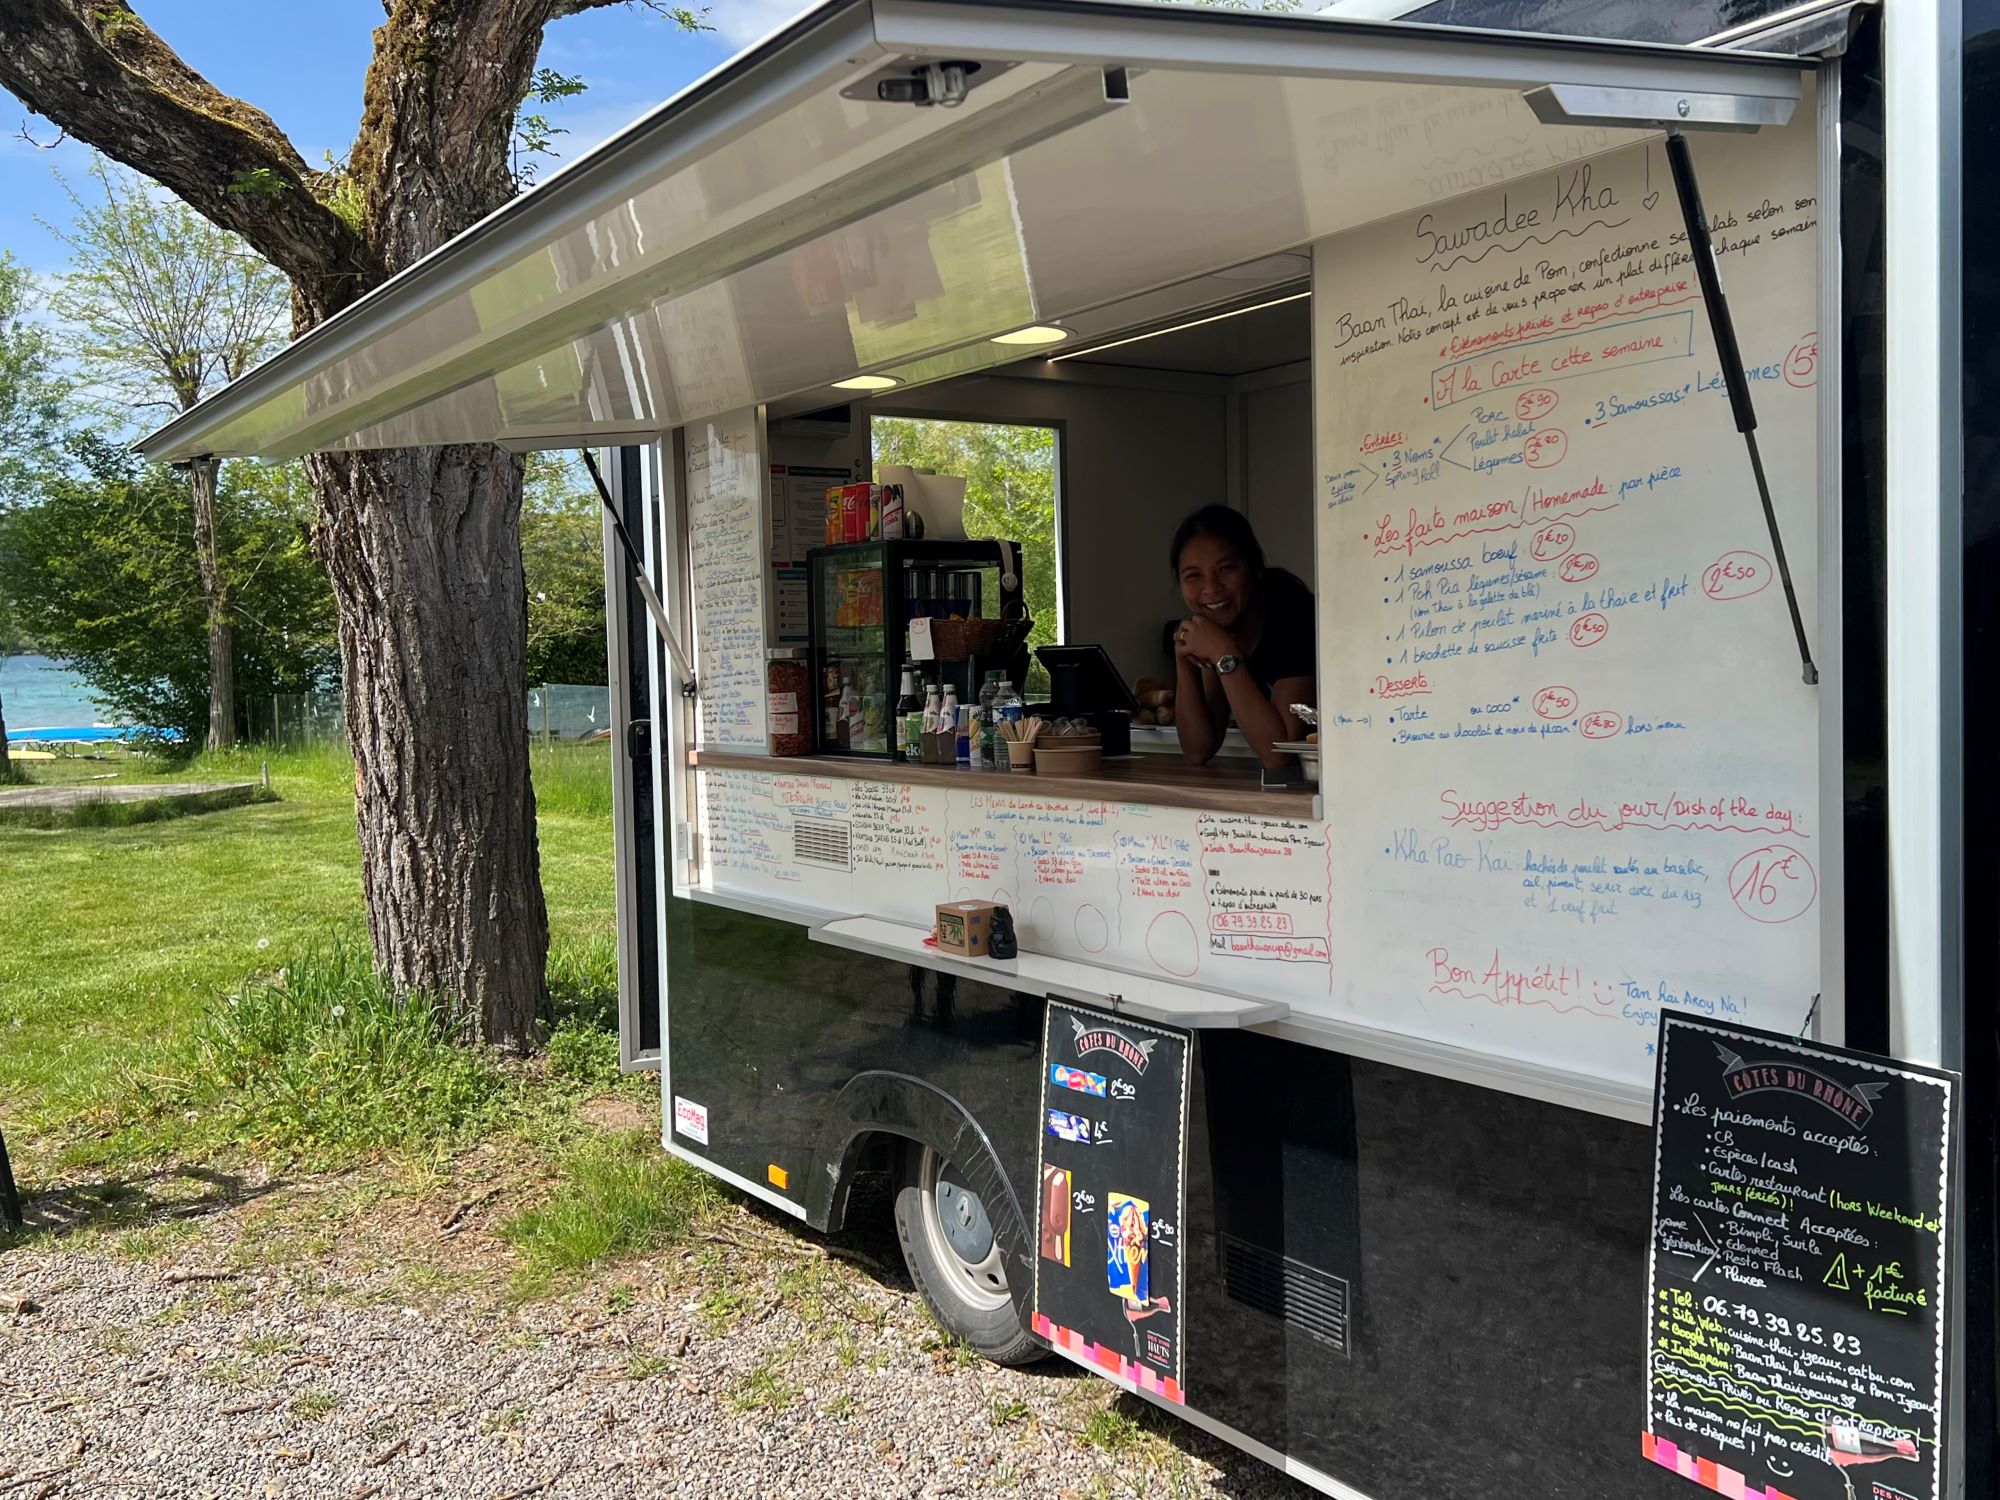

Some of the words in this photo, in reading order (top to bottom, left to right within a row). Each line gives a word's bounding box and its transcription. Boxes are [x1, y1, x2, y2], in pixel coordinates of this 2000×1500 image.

[1552, 164, 1620, 221] Kha
[1334, 312, 1386, 348] Baan
[1437, 284, 1458, 311] la
[1463, 281, 1510, 304] cuisine
[1513, 266, 1532, 289] de
[1579, 239, 1660, 274] confectionne
[1746, 200, 1784, 220] selon
[1794, 198, 1817, 211] son
[1398, 327, 1421, 344] Notre
[1425, 313, 1462, 335] concept
[1466, 308, 1480, 322] est
[1486, 303, 1499, 317] de
[1502, 298, 1527, 312] vous
[1532, 281, 1587, 310] proposer
[1593, 276, 1613, 290] un
[1616, 266, 1645, 289] plat
[1714, 235, 1761, 256] chaque
[1561, 309, 1573, 323] et
[1577, 301, 1609, 318] repas
[1462, 366, 1482, 392] la
[1491, 355, 1543, 388] Carte
[1551, 345, 1592, 370] cette
[1602, 336, 1664, 359] semaine
[1595, 401, 1606, 421] 3
[1467, 432, 1499, 451] Poulet
[1501, 422, 1536, 442] halal
[1392, 451, 1401, 466] 3
[1473, 453, 1525, 475] Légumes
[1384, 469, 1420, 491] Spring
[1374, 512, 1400, 546] Les
[1402, 504, 1445, 556] faits
[1453, 501, 1518, 526] maison
[1618, 478, 1644, 500] par
[1648, 466, 1682, 492] pièce
[1394, 570, 1404, 583] 1
[1409, 557, 1473, 579] samoussa
[1395, 591, 1404, 602] 1
[1396, 628, 1404, 641] 1
[1411, 621, 1446, 638] Pilon
[1452, 619, 1466, 633] de
[1470, 610, 1514, 640] poulet
[1521, 605, 1561, 623] mariné
[1568, 602, 1577, 615] à
[1581, 592, 1596, 611] la
[1644, 583, 1656, 601] et
[1661, 575, 1688, 610] frit
[1708, 562, 1756, 593] 2€50
[1468, 593, 1478, 606] la
[1508, 591, 1519, 599] de
[1400, 650, 1408, 663] 1
[1413, 645, 1462, 663] brochette
[1468, 644, 1478, 654] de
[1395, 705, 1429, 721] Tarte
[1470, 707, 1483, 715] ou
[1439, 731, 1450, 739] au
[1454, 723, 1492, 738] chocolat
[1494, 727, 1504, 736] et
[1529, 722, 1538, 733] de
[1440, 789, 1558, 832] Suggestion
[1568, 797, 1607, 821] du
[1710, 798, 1725, 822] of
[1730, 797, 1758, 817] the
[1394, 827, 1429, 863] Kha
[1432, 836, 1472, 868] Pao
[1644, 866, 1659, 874] au
[1733, 855, 1800, 905] 16€
[1629, 886, 1654, 897] avec
[1662, 886, 1678, 899] du
[1682, 889, 1702, 908] riz
[1425, 947, 1476, 984] Bon
[1619, 980, 1650, 1000] Tan
[1622, 1004, 1657, 1026] Enjoy
[1106, 1034, 1116, 1048] DU
[1787, 1070, 1806, 1090] DU
[1682, 1093, 1707, 1116] Les
[1711, 1107, 1796, 1136] paiements
[1803, 1130, 1869, 1154] acceptés
[1714, 1130, 1734, 1146] CB
[1708, 1161, 1747, 1183] Cartes
[1750, 1175, 1826, 1203] restaurant
[1866, 1201, 1924, 1228] Weekend
[1669, 1185, 1690, 1203] Les
[1693, 1197, 1730, 1214] cartes
[1732, 1202, 1790, 1230] Connect
[1800, 1217, 1870, 1247] Acceptées
[1726, 1239, 1779, 1260] Edenred
[1723, 1250, 1759, 1269] Resto
[1764, 1261, 1803, 1281] Flash
[1864, 1280, 1927, 1310] facturé
[1672, 1307, 1696, 1325] Site
[1672, 1323, 1708, 1346] Google
[1794, 1360, 1807, 1377] la
[1809, 1369, 1848, 1388] cuisine
[1851, 1378, 1866, 1394] de
[1870, 1382, 1895, 1402] Pom
[1756, 1398, 1772, 1408] ou
[1665, 1409, 1682, 1427] Pas
[1685, 1418, 1697, 1432] de
[1700, 1427, 1745, 1451] chèques
[1684, 1405, 1723, 1424] maison
[1727, 1419, 1740, 1430] ne
[1764, 1430, 1787, 1447] pas
[1790, 1441, 1832, 1465] crédit
[1872, 1487, 1892, 1499] DES
